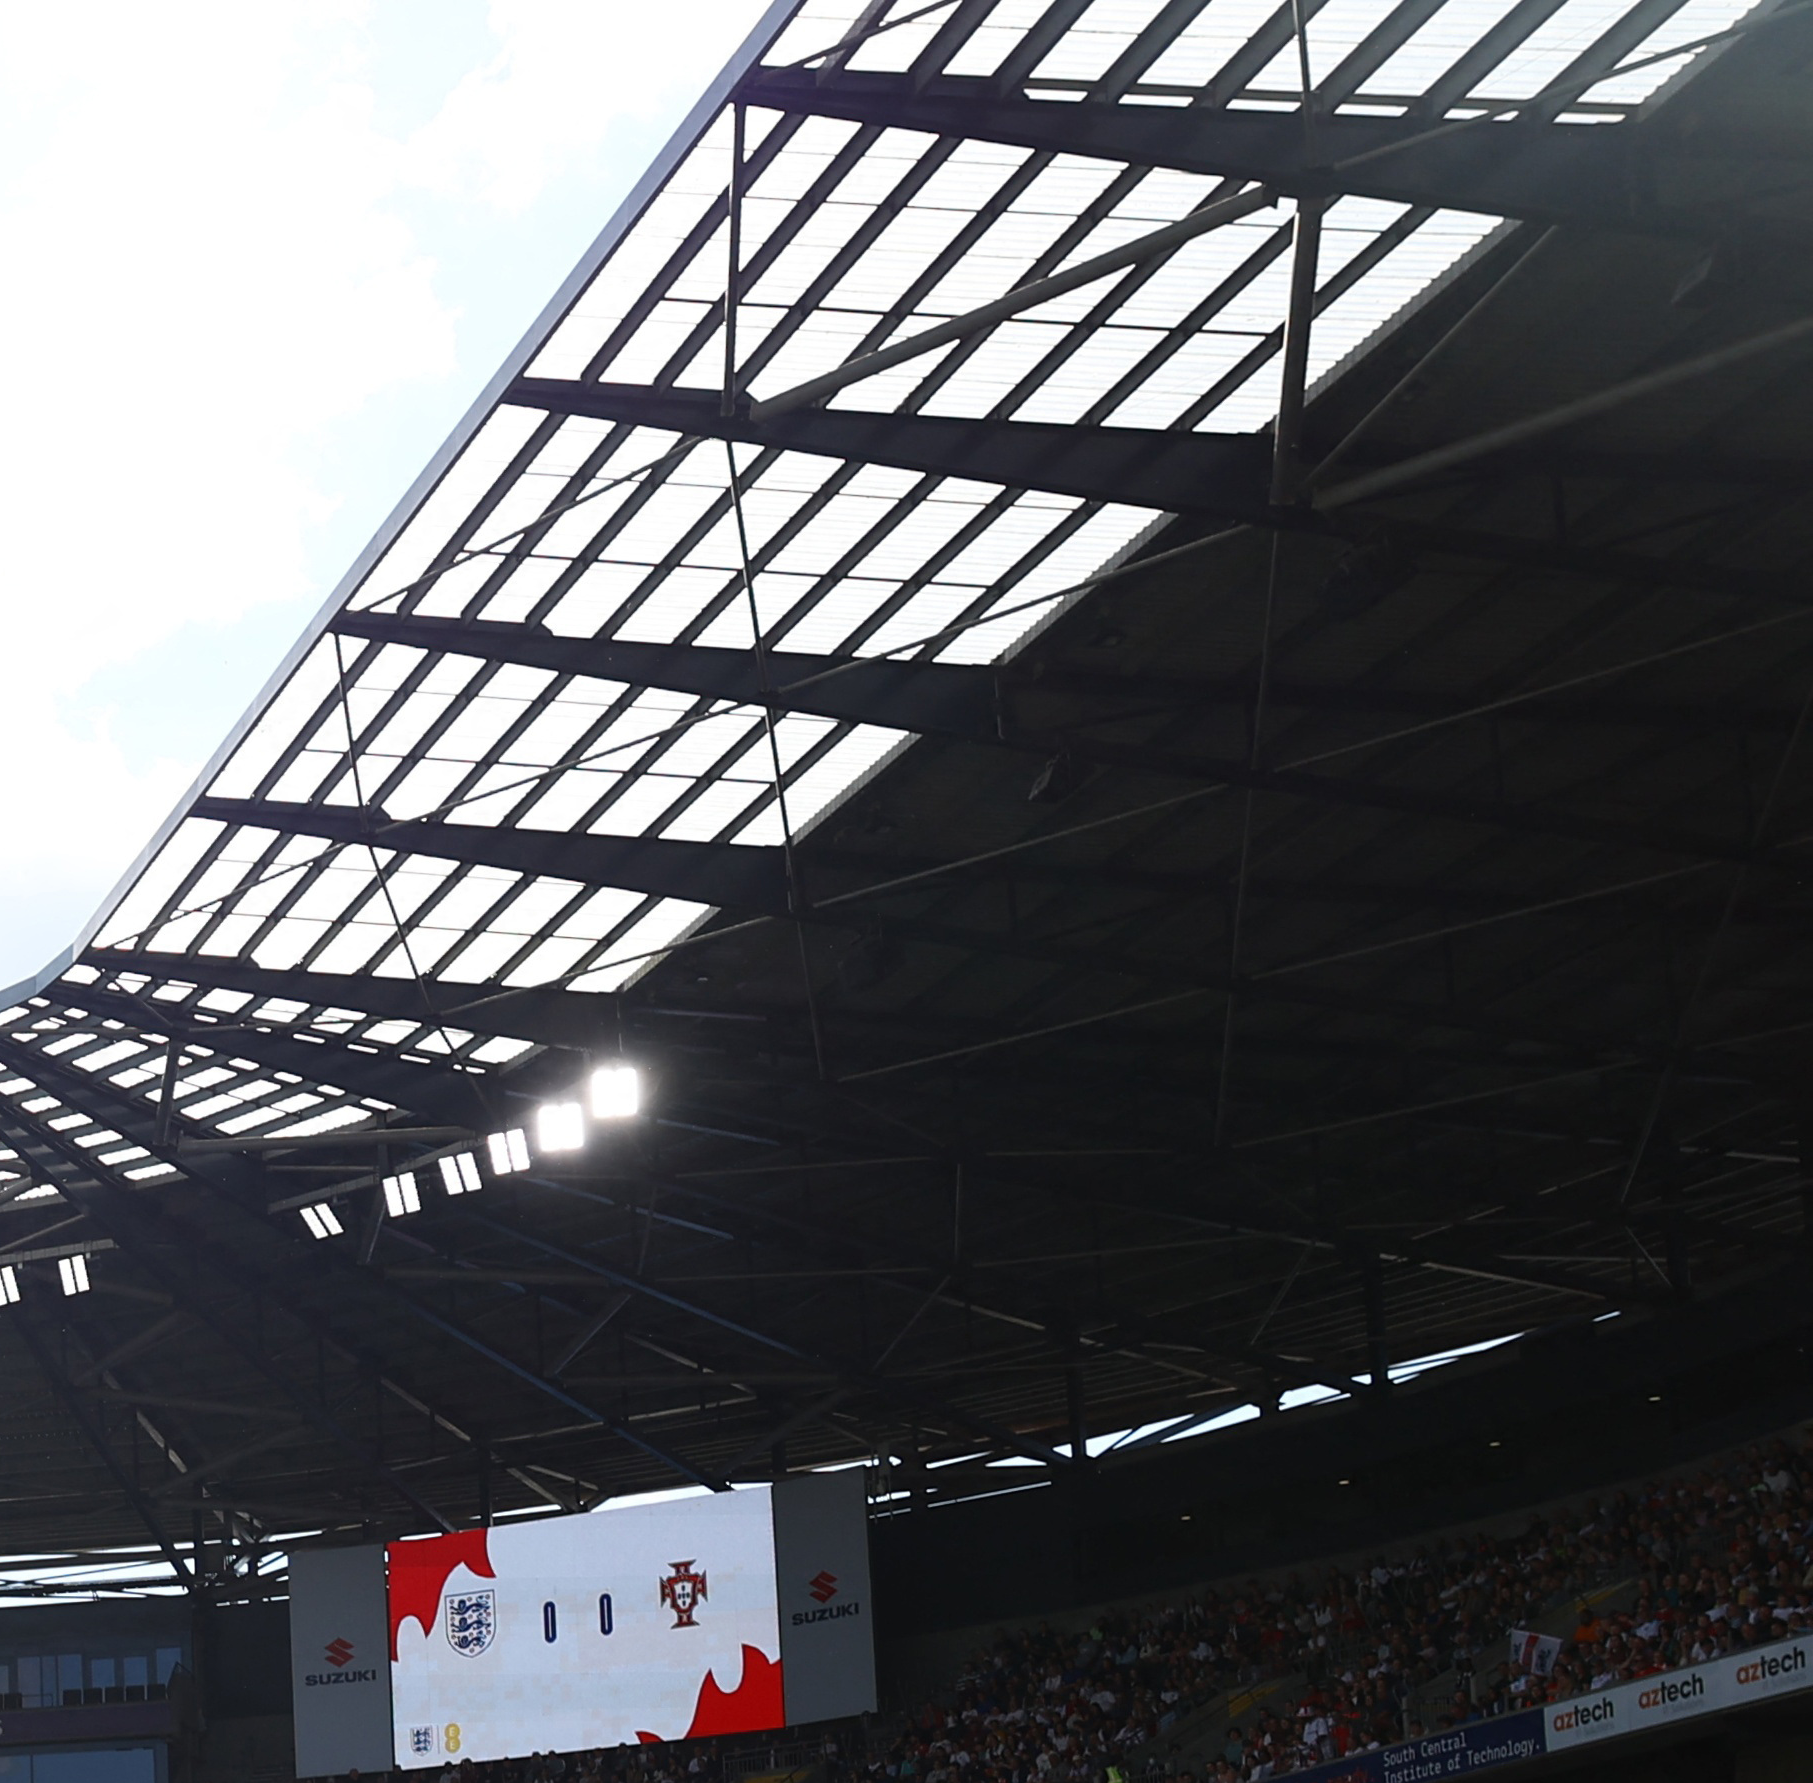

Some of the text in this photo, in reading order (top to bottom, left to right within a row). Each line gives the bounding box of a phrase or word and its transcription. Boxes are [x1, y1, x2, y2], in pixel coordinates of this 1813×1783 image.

[791, 1602, 860, 1627] SUZUKI
[305, 1669, 377, 1687] SUZUKI
[1736, 1647, 1806, 1685] aztech
[1638, 1673, 1705, 1710] aztech
[1553, 1698, 1615, 1732] aztech
[1383, 1731, 1468, 1768] South Central
[1447, 1754, 1461, 1772] of
[1468, 1737, 1540, 1766] Technology.
